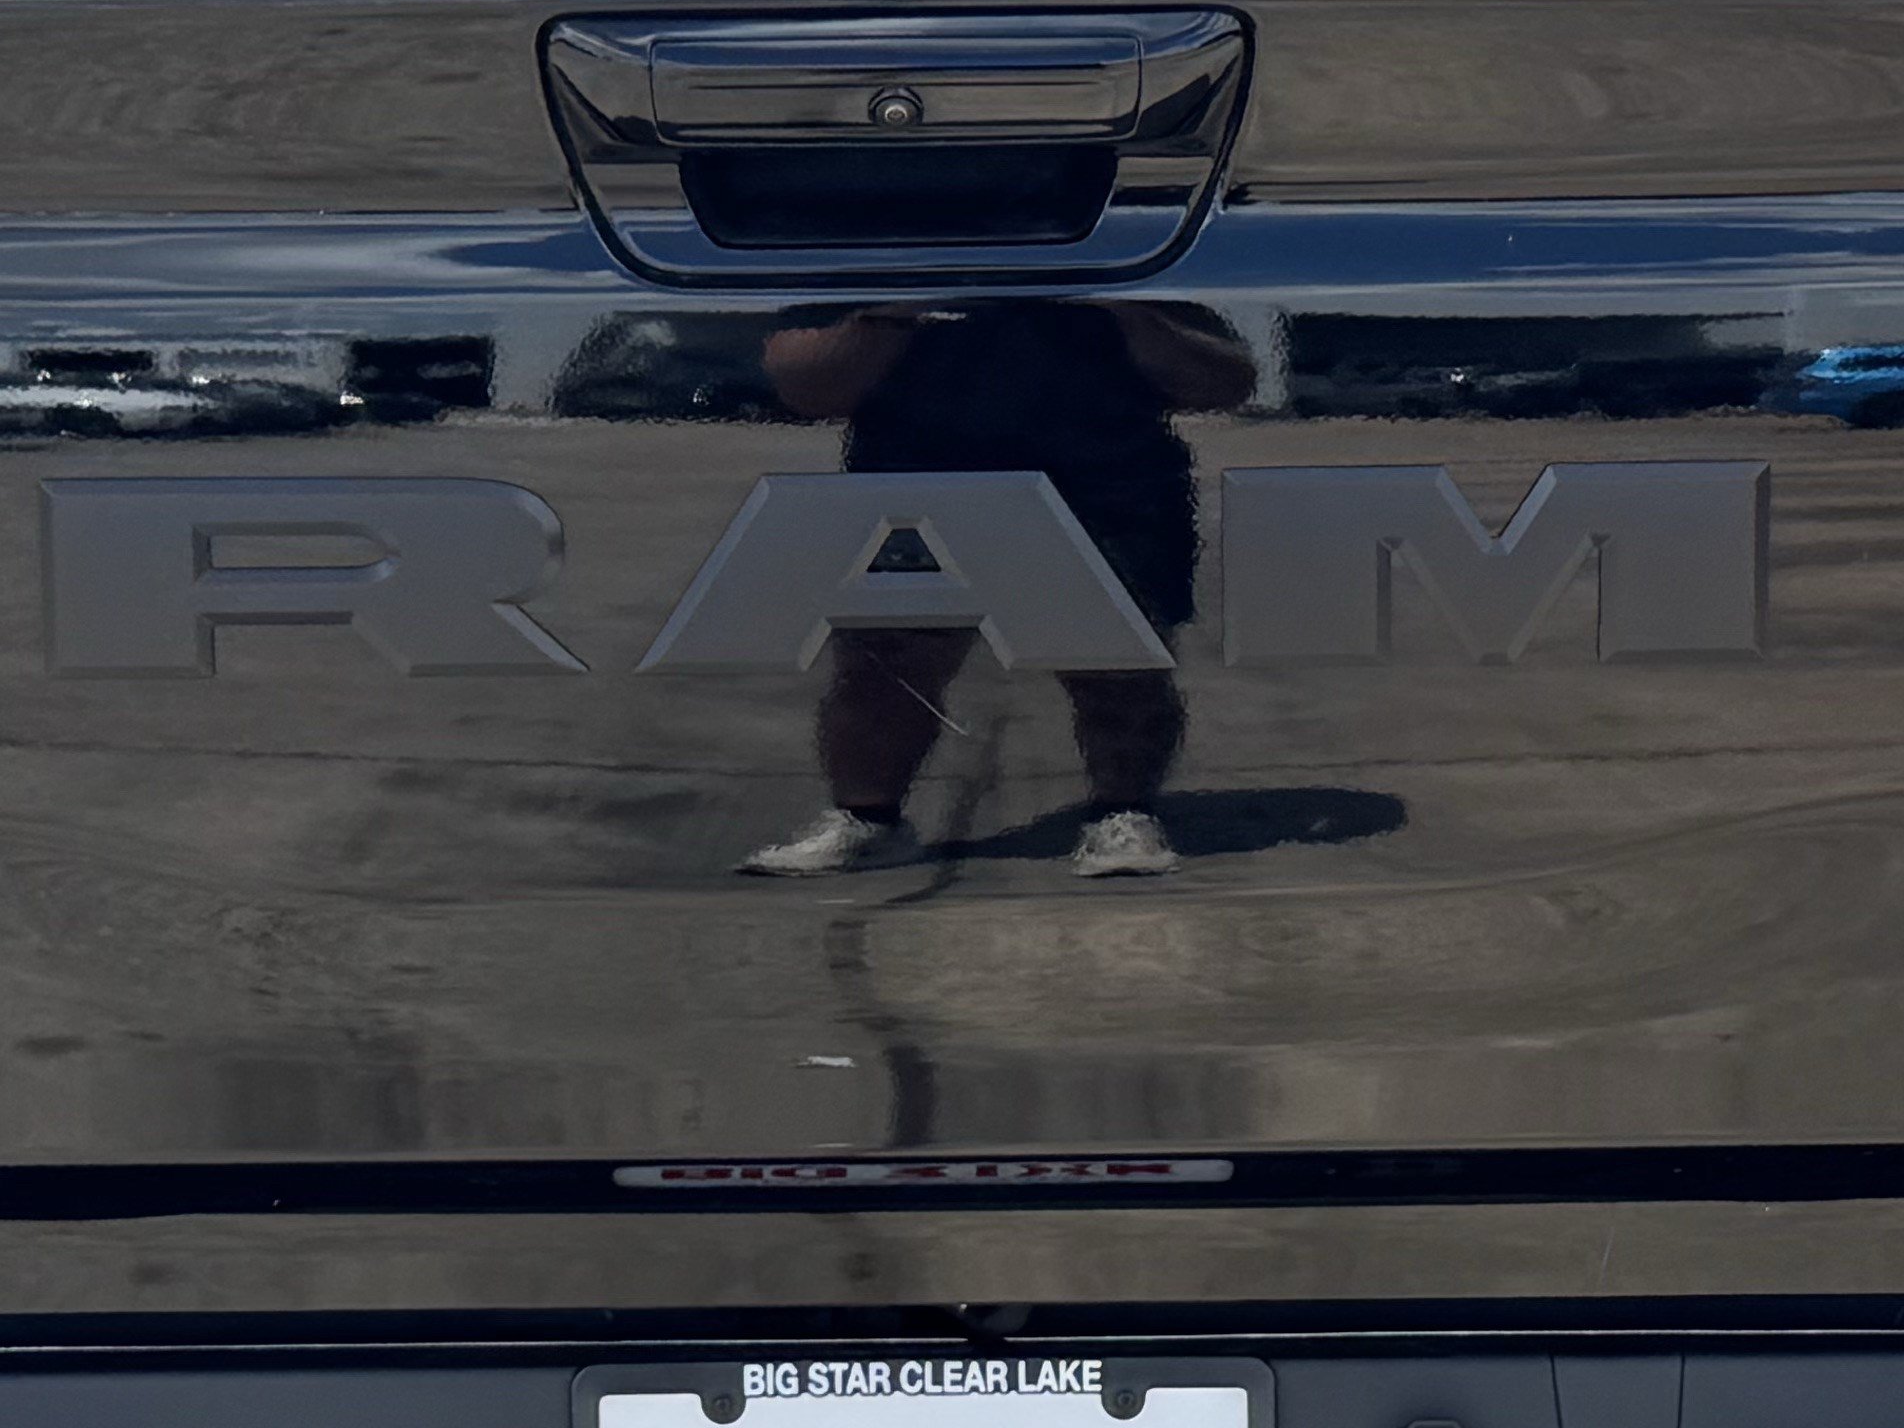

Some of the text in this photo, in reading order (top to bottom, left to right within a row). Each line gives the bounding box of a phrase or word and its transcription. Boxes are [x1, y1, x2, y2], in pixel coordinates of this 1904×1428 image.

[39, 460, 1770, 677] RAM
[742, 1359, 1103, 1396] BIG STAR CLEAR LAKE
